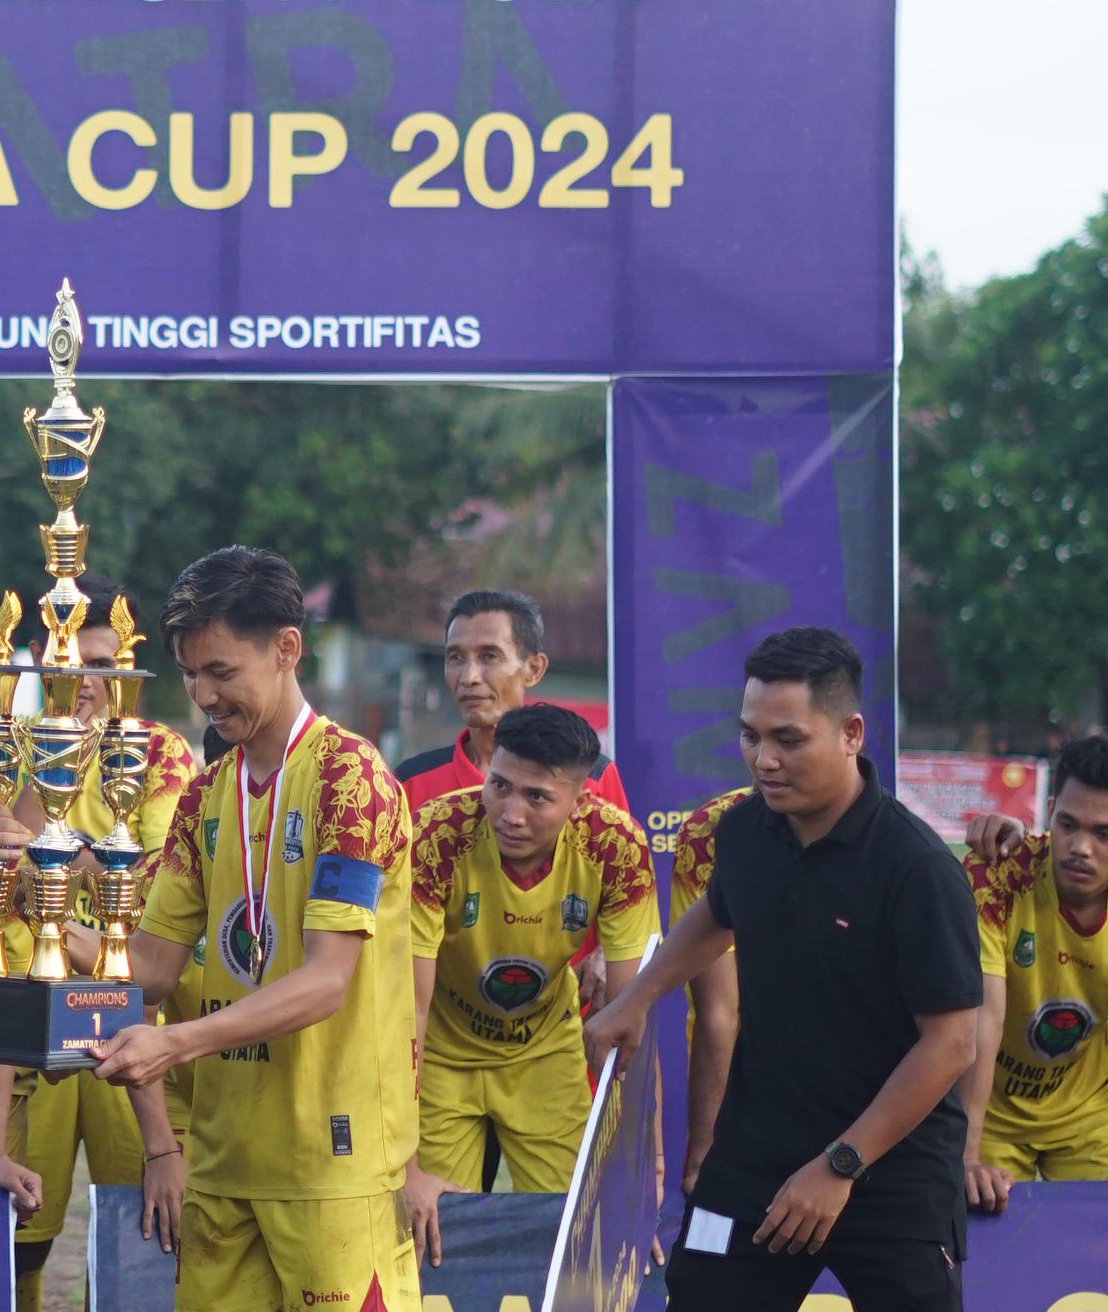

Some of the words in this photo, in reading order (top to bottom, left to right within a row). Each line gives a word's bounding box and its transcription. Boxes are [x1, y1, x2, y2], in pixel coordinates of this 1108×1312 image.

[67, 109, 349, 209] CUP
[390, 112, 684, 209] 2024
[89, 316, 218, 349] TINGGI
[229, 316, 481, 349] SPORTIFITAS
[315, 862, 342, 897] C
[66, 991, 129, 1008] CHAMPIONS
[92, 1012, 103, 1036] 1
[996, 1050, 1046, 1081] ARANG
[302, 1289, 351, 1307] brichie
